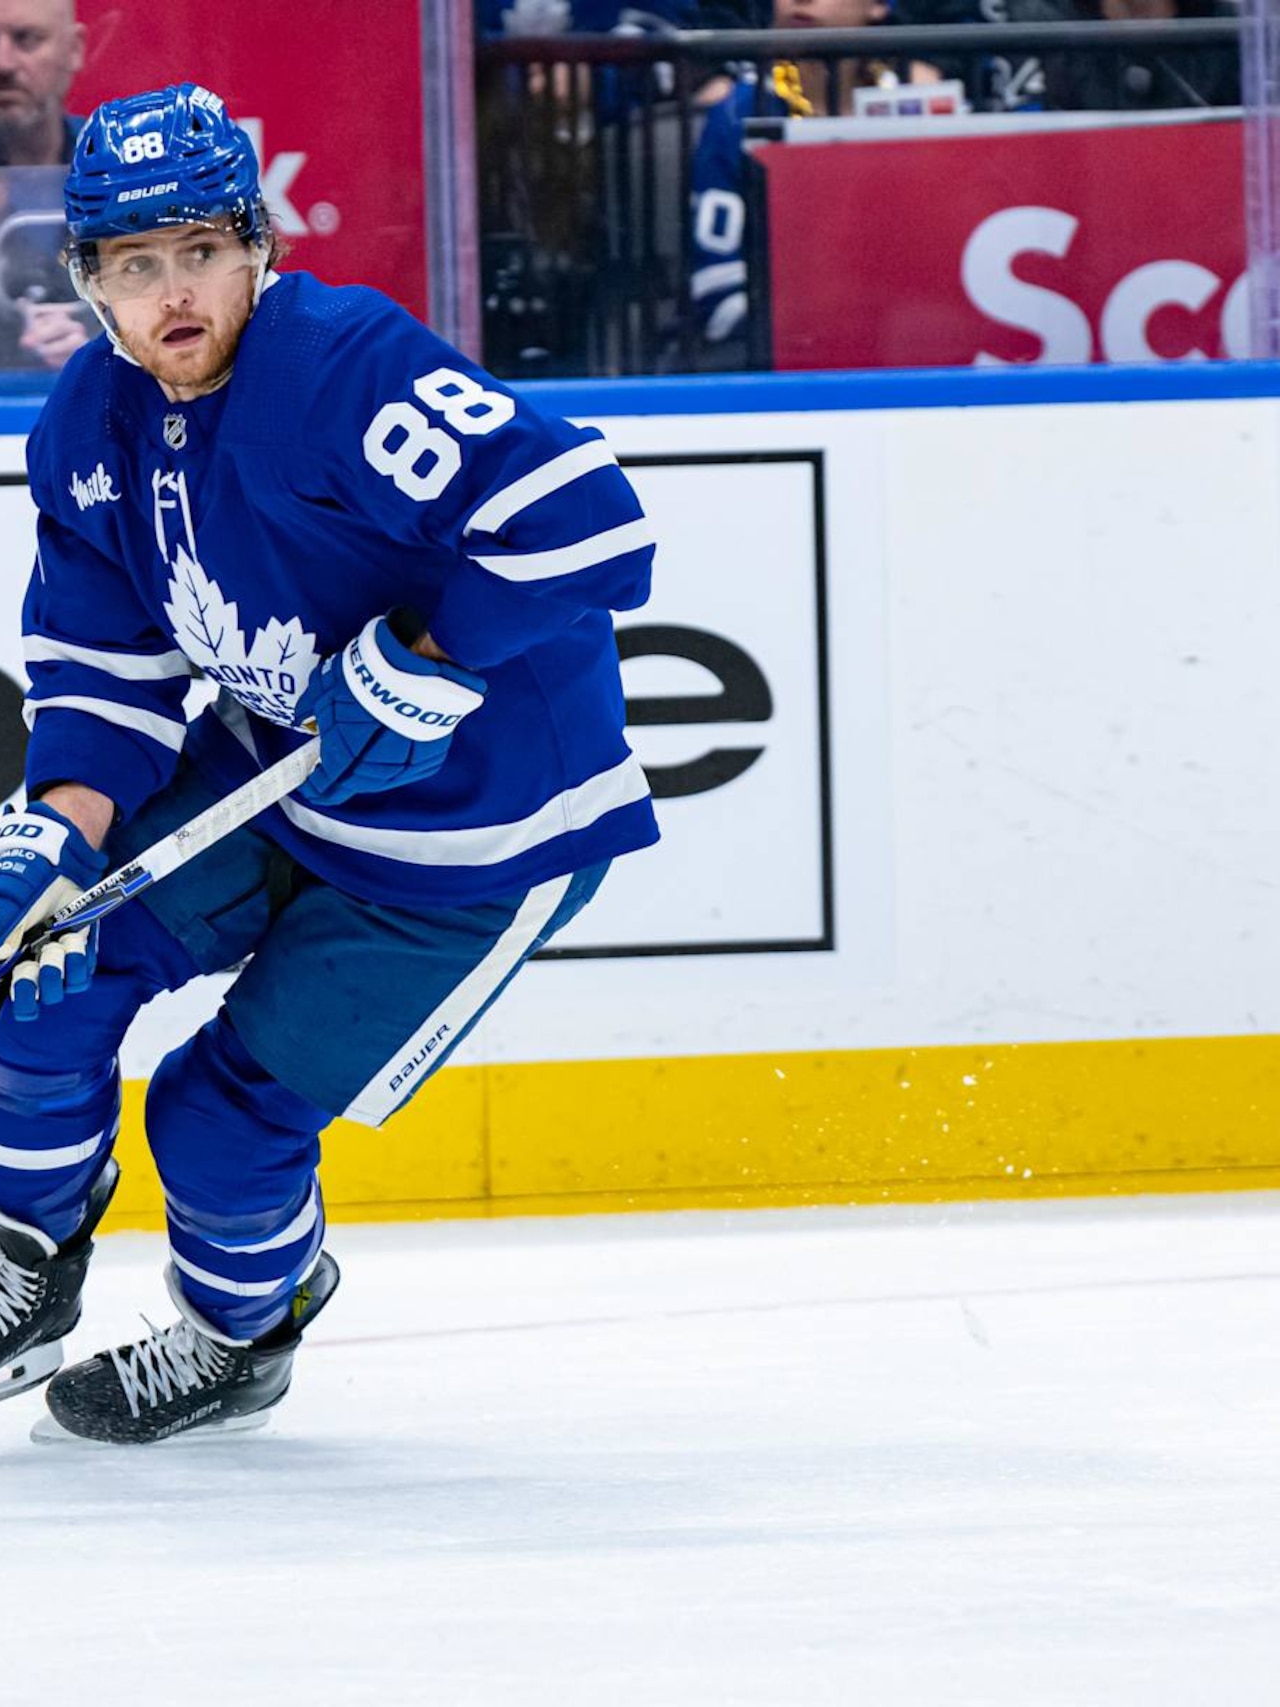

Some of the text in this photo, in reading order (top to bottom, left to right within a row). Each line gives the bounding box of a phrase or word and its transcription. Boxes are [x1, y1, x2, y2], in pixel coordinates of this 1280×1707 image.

[123, 131, 165, 164] 88
[363, 367, 516, 502] 88
[202, 664, 296, 695] RONTO
[389, 1024, 450, 1092] BAUER
